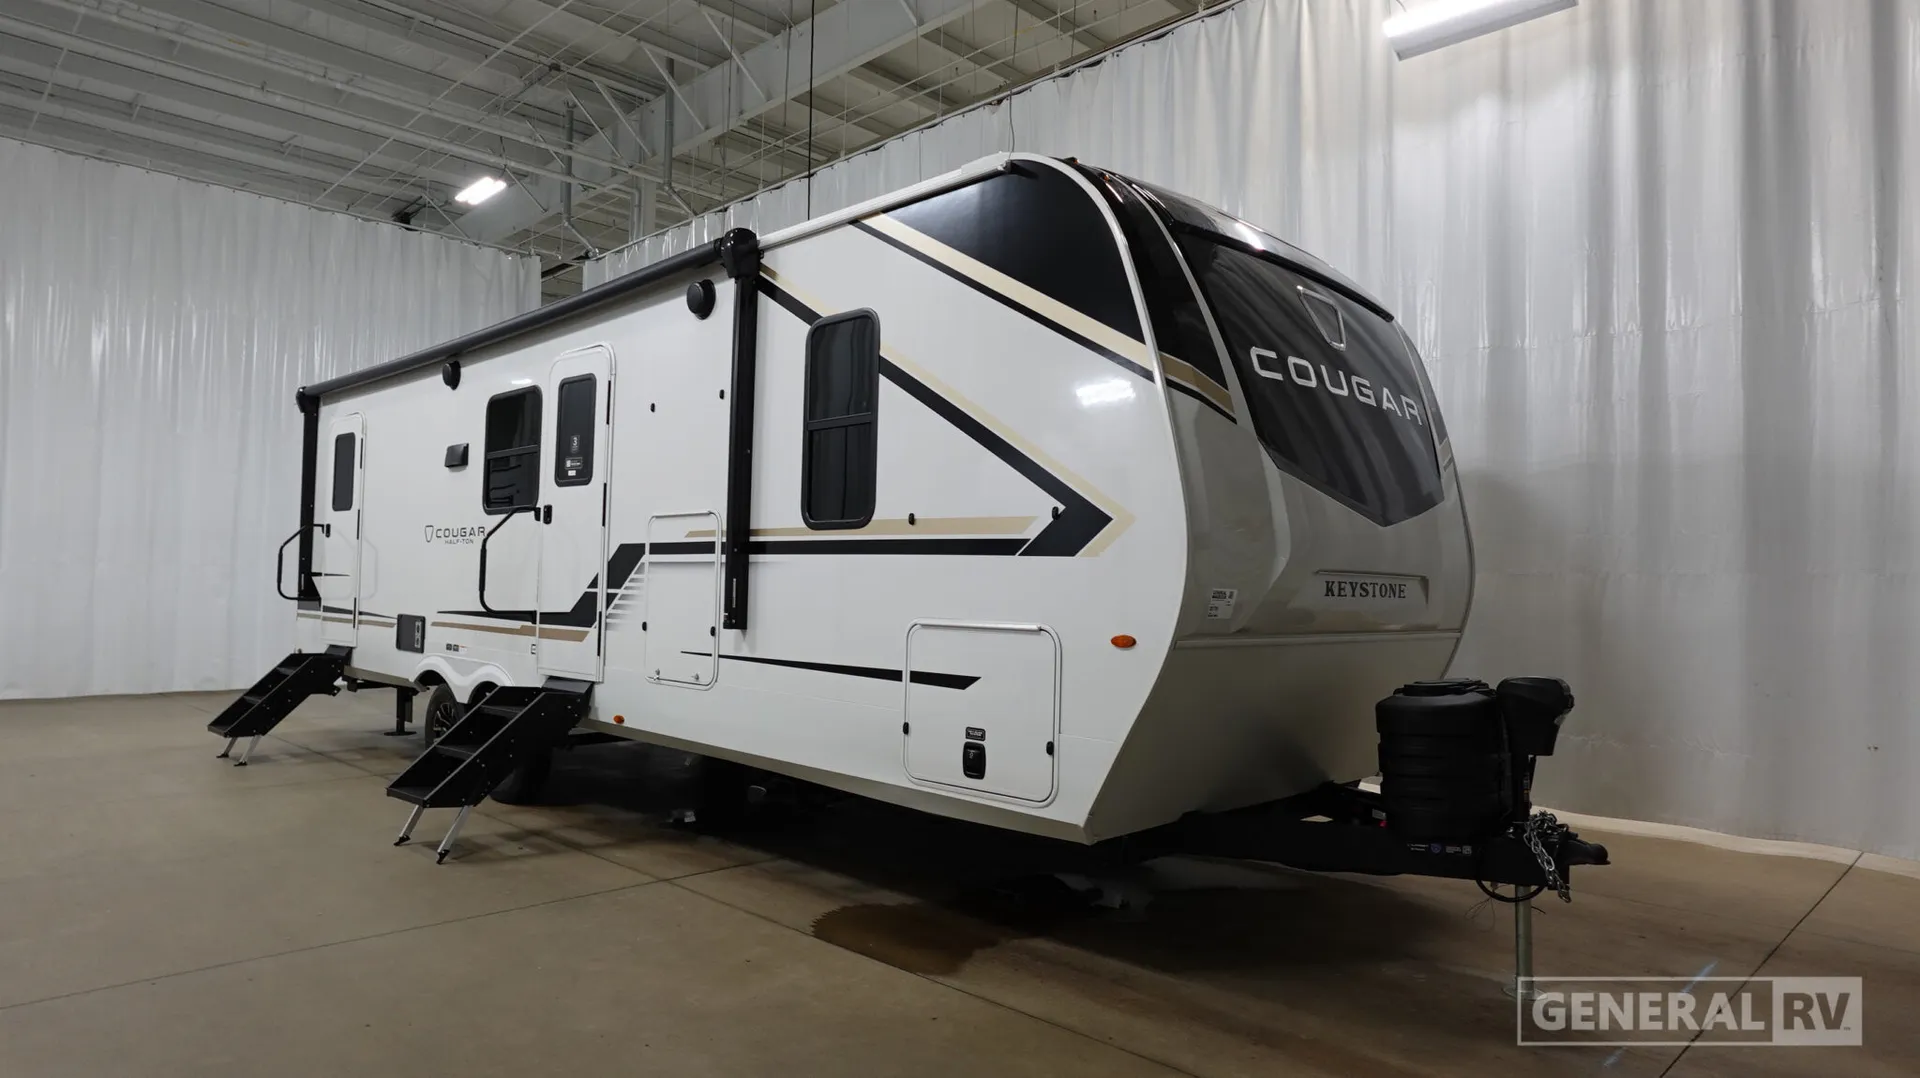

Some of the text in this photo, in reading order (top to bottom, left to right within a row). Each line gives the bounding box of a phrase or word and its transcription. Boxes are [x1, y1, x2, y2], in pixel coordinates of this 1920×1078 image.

[1250, 346, 1422, 426] COUGAR
[435, 526, 486, 538] COUGAR
[1324, 580, 1407, 599] KEYSTONE
